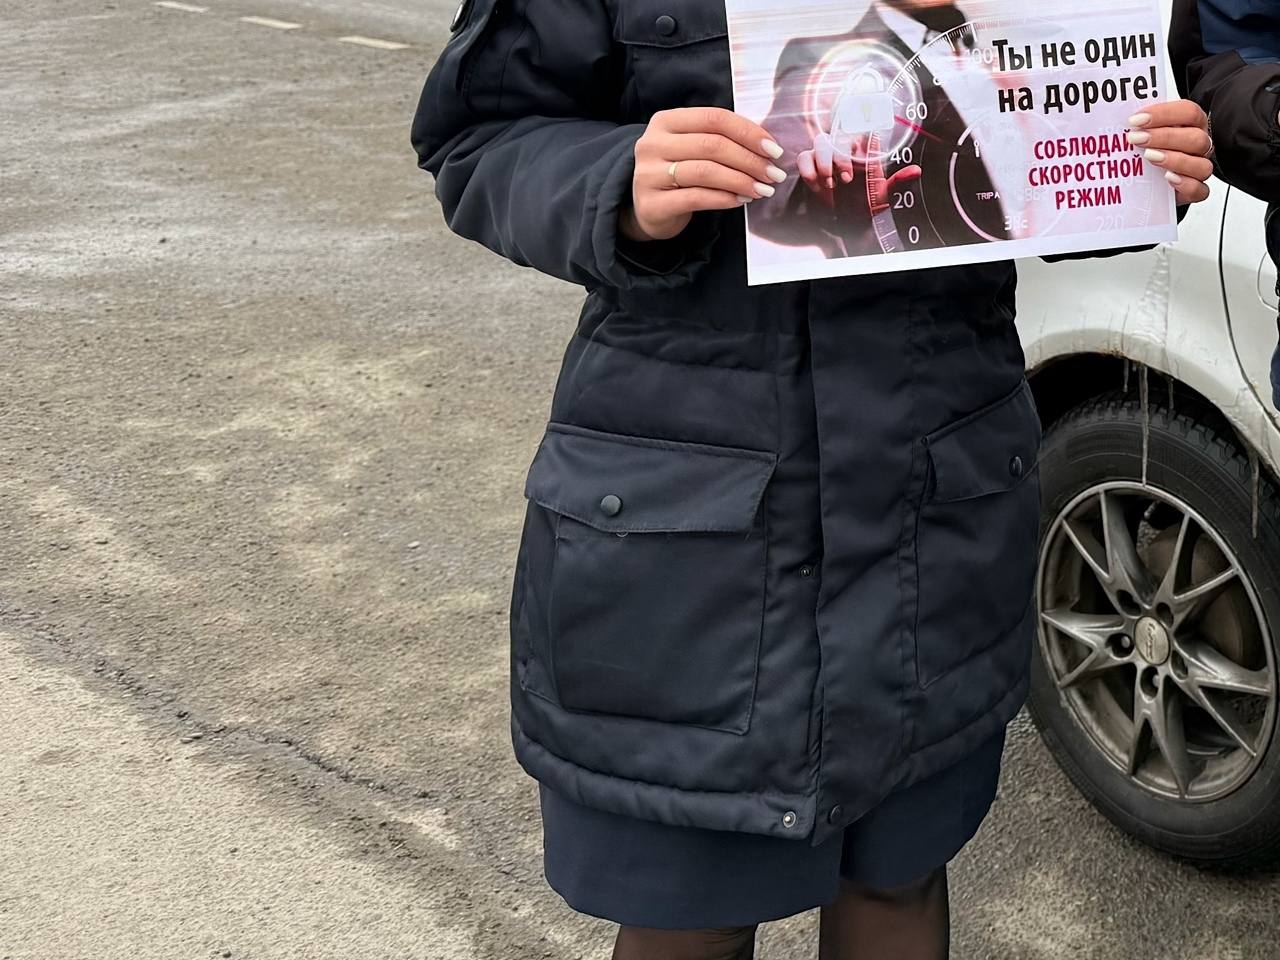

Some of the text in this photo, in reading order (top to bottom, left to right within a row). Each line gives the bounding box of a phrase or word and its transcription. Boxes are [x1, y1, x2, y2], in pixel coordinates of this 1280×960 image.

[992, 33, 1156, 71] Ты не один
[998, 64, 1158, 115] на дороге!
[906, 102, 927, 120] 60
[891, 147, 912, 164] 40
[1033, 129, 1134, 161] СОБЛЮДАЙ
[1028, 154, 1143, 187] СКОРОСТНОЙ
[893, 191, 914, 209] 20
[976, 192, 994, 201] TRIP
[1055, 185, 1122, 210] РЕЖИМ
[909, 226, 919, 243] 0
